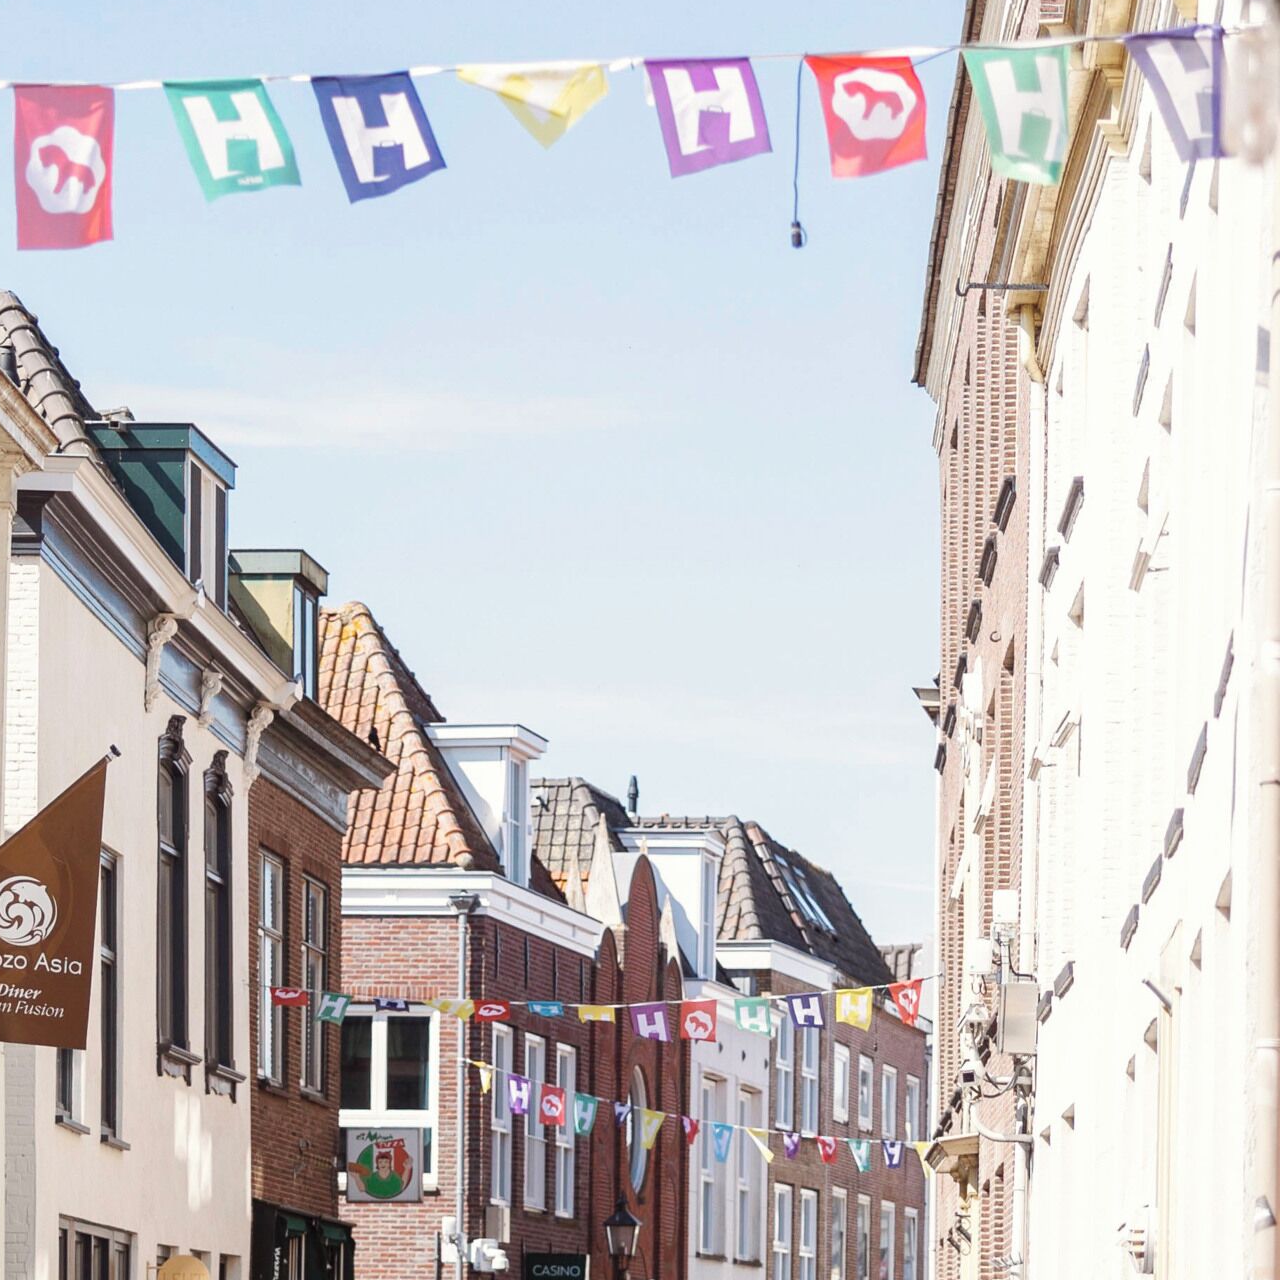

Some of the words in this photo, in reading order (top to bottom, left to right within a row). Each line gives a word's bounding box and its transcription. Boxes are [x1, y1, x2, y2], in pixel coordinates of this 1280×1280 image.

[663, 66, 756, 156] H
[984, 55, 1065, 161] H
[182, 91, 286, 180] H
[331, 92, 431, 183] H
[34, 952, 82, 975] Asia
[15, 1000, 65, 1018] Fusion
[318, 994, 348, 1018] H
[792, 996, 824, 1025] H
[636, 1011, 668, 1042] H
[532, 1264, 581, 1277] CASINO
